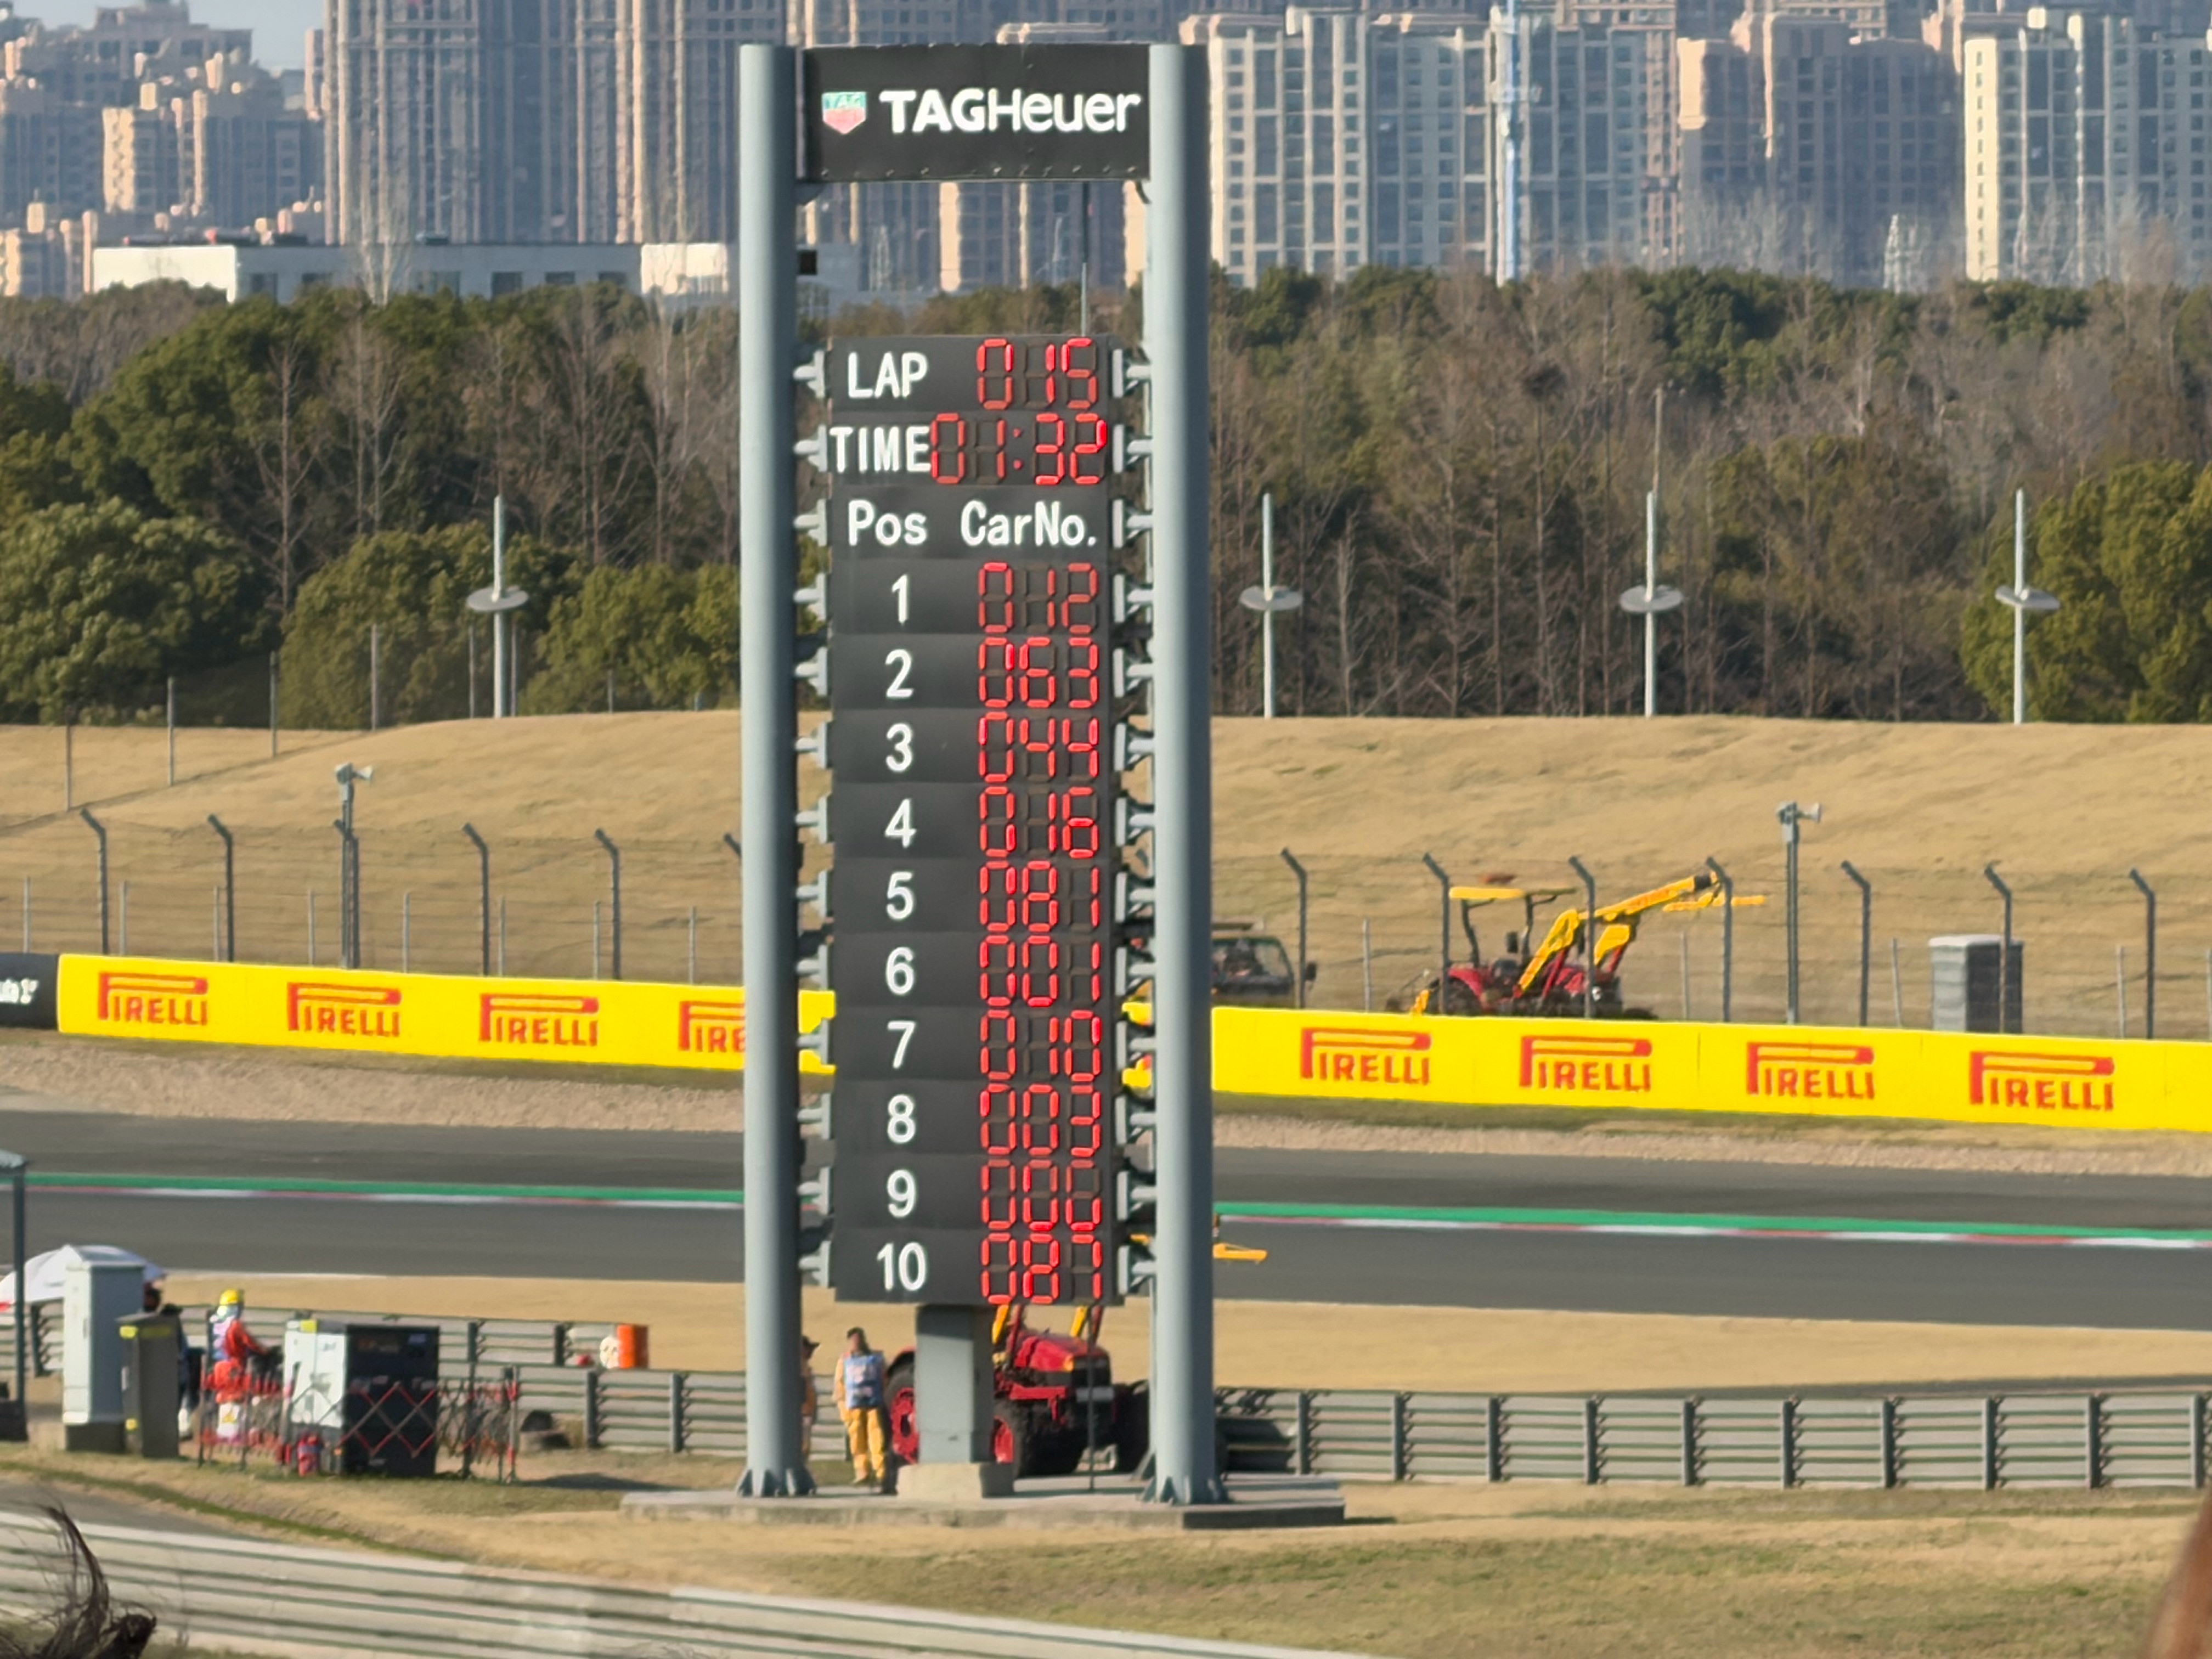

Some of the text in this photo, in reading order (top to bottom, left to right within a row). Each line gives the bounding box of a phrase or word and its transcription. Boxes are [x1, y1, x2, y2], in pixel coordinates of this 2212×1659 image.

[848, 337, 1097, 409] LAP 015
[829, 413, 1107, 485] TIME 01:32
[848, 499, 927, 546] Pos
[891, 562, 1097, 634] 1 012
[885, 637, 1098, 708] 2 063
[885, 712, 1098, 783] 3 044
[884, 786, 1099, 859] 4 016
[886, 860, 1099, 933] 5 081
[98, 972, 208, 1025] PIRELLI
[885, 935, 1100, 1007] 6 001
[286, 982, 402, 1037] PIRELLI
[479, 994, 599, 1046] PIRELLI
[678, 1001, 745, 1052] PIRE
[887, 1009, 1102, 1082] 7 010
[1300, 1028, 1432, 1085] PIRELLI
[1519, 1035, 1652, 1091] PIRELLI
[1746, 1042, 1875, 1099] PIRELLI
[1970, 1051, 2115, 1111] PIRELLI
[887, 1084, 1102, 1157] 8 003
[887, 1169, 917, 1218] 9
[877, 1232, 1102, 1305] 10 087
